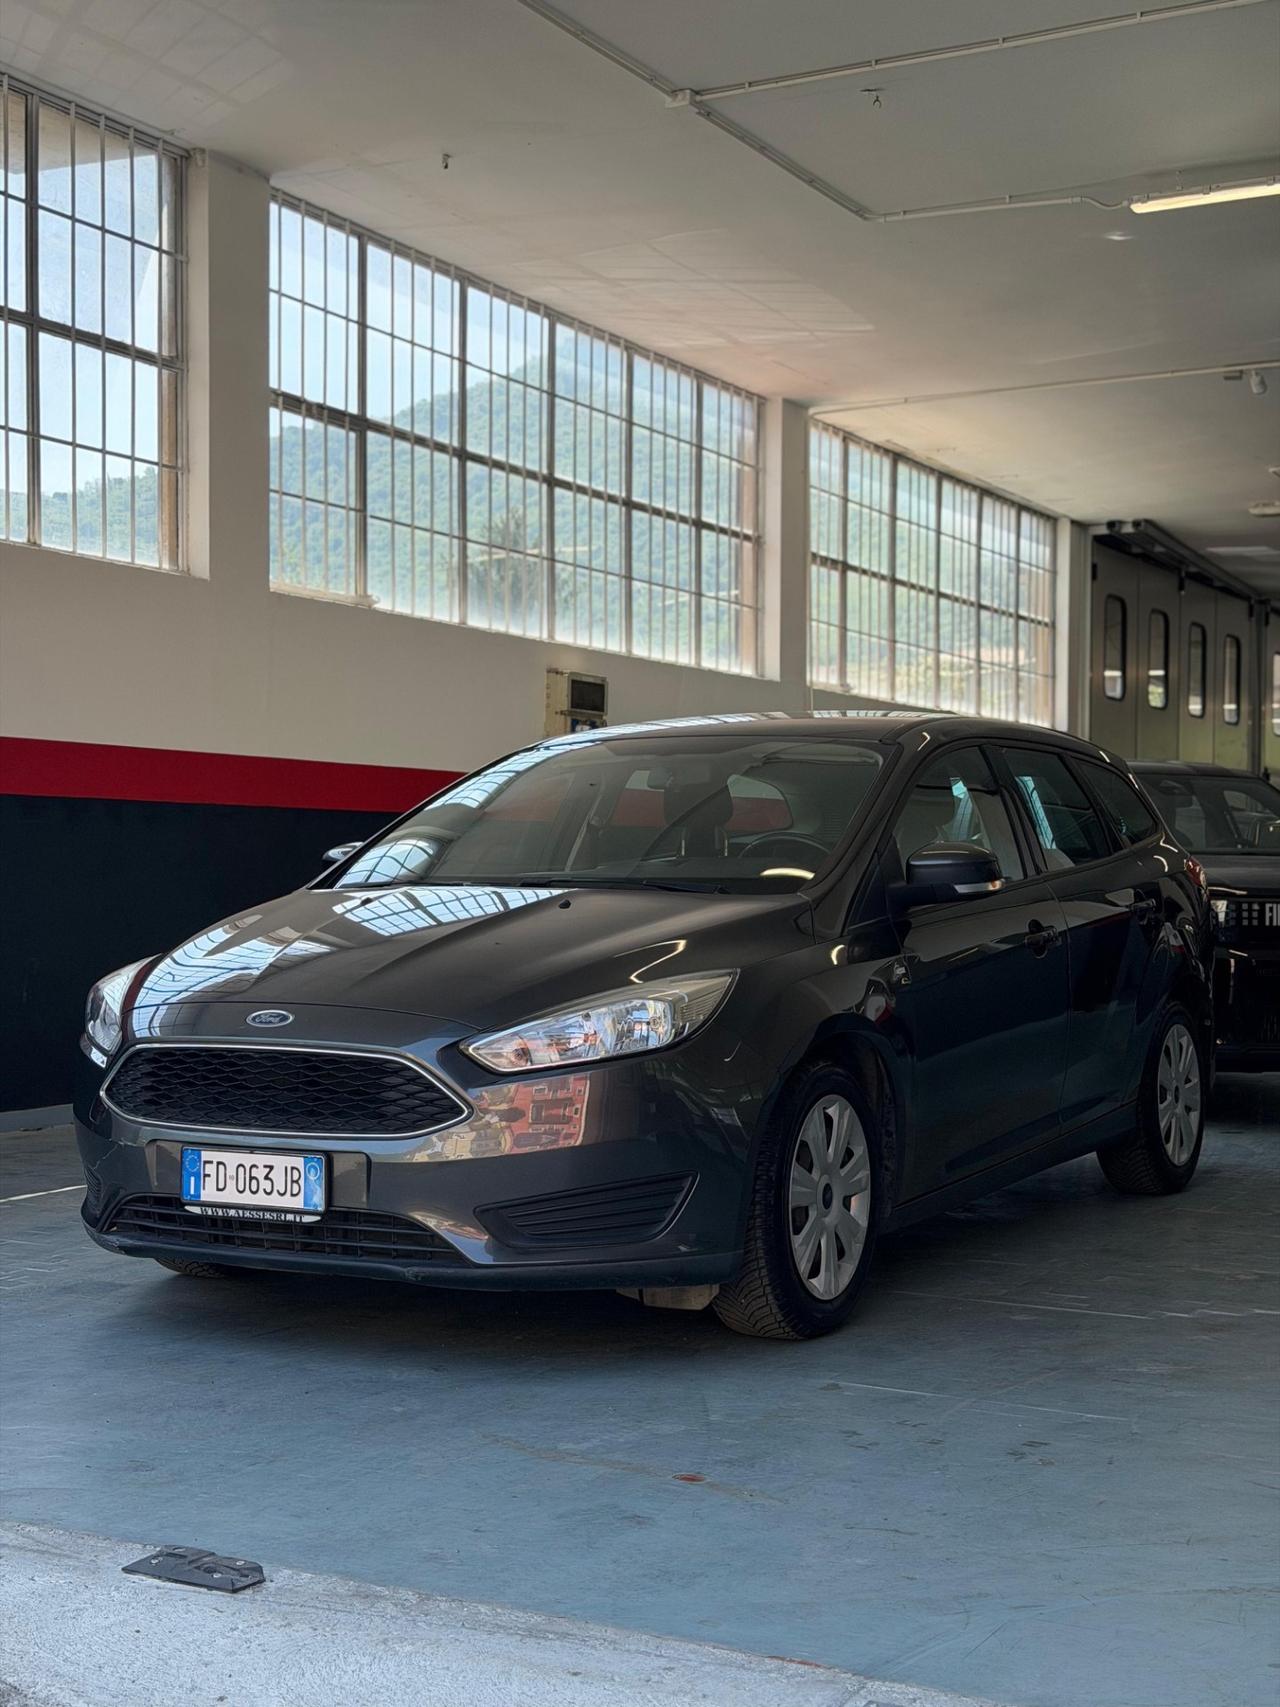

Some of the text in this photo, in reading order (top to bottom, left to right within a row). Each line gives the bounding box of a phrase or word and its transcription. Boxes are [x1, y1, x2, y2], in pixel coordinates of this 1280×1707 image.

[253, 1011, 286, 1025] Ford
[202, 1160, 302, 1198] FD 063JB
